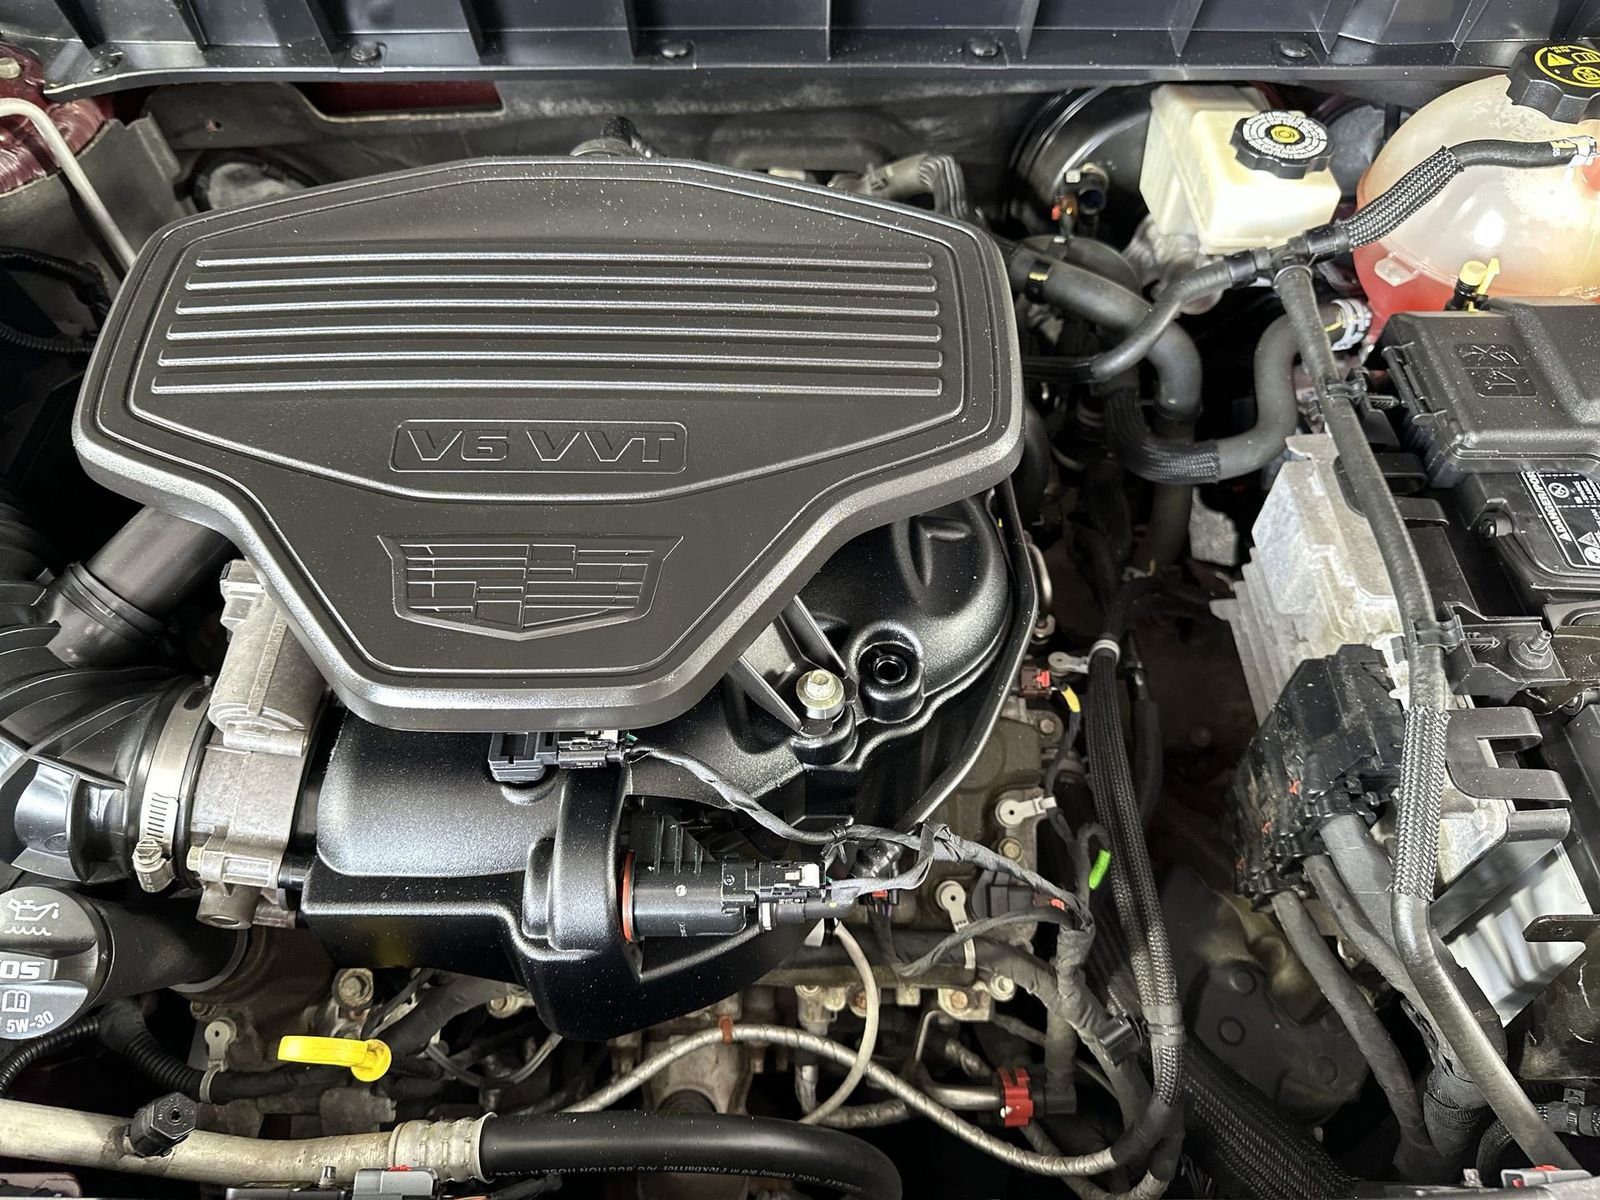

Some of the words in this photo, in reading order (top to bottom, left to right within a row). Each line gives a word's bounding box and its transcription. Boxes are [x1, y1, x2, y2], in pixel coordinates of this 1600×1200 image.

[407, 429, 510, 462] V6
[526, 429, 677, 463] VVT
[6, 1010, 54, 1033] 5W-30
